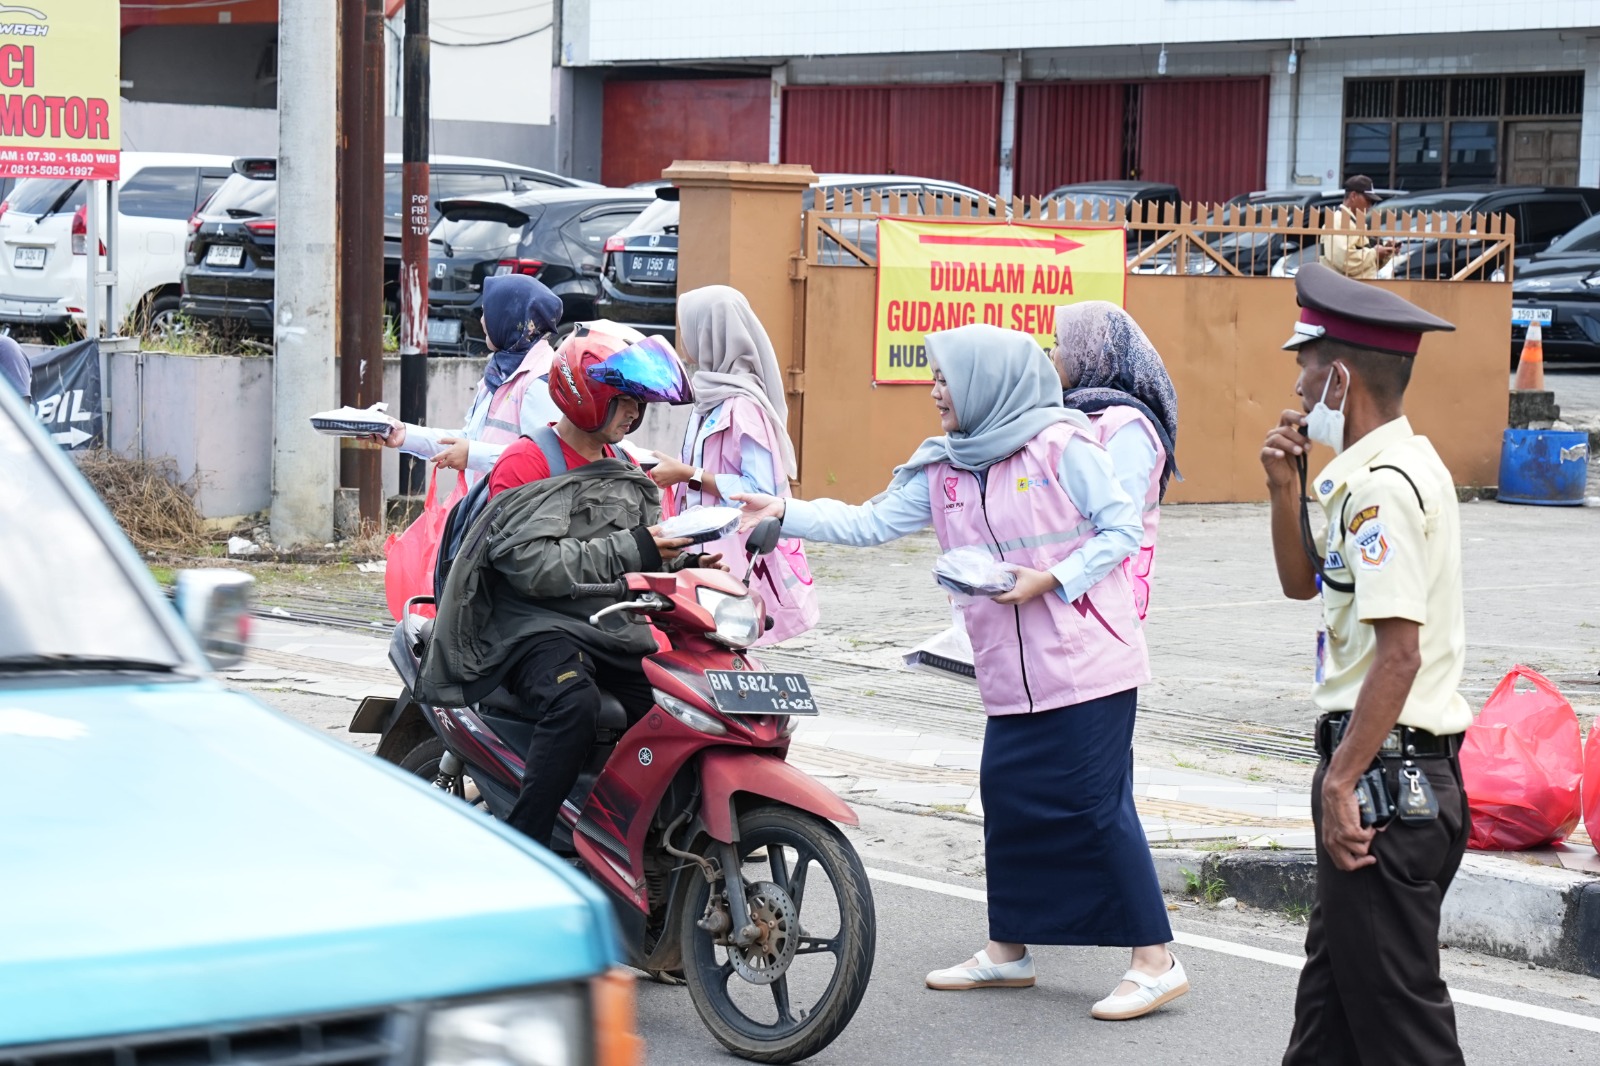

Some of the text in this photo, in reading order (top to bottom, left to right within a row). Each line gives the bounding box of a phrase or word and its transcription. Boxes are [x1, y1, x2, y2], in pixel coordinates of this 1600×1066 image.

[0, 93, 110, 140] MOTOR
[0, 150, 18, 161] AM
[26, 151, 57, 162] 07.30
[65, 152, 94, 163] 18.00
[96, 154, 116, 163] WIB
[10, 164, 95, 176] 0813-5050-1997
[632, 256, 643, 270] BG
[646, 257, 665, 271] 1565
[930, 261, 1074, 296] DIDALAM ADA
[887, 300, 976, 332] GUDANG
[983, 303, 1003, 327] DI
[1517, 309, 1536, 320] 1593
[1536, 310, 1551, 320] WNR
[1028, 479, 1049, 487] PLN
[708, 673, 734, 691] BN
[736, 674, 779, 692] 6824
